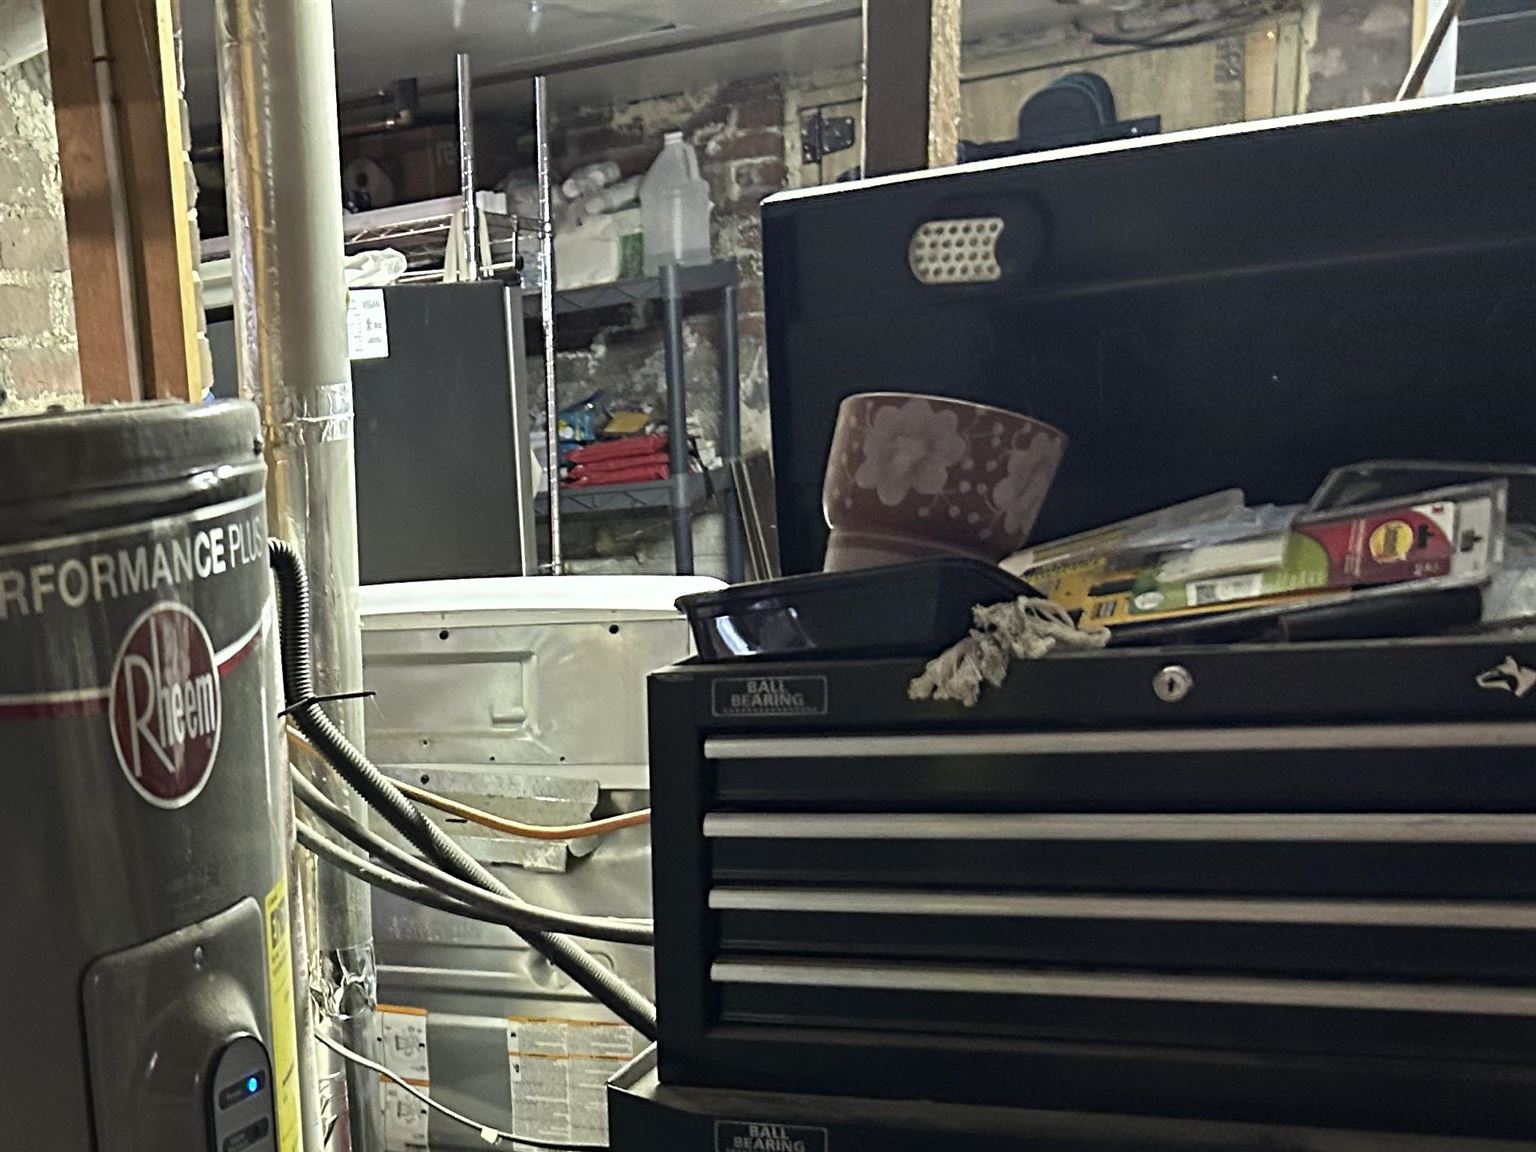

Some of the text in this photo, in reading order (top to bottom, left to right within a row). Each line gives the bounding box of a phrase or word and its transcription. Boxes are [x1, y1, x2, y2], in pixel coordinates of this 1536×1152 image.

[228, 516, 263, 568] PLUS
[747, 680, 786, 693] BALL
[122, 614, 216, 777] Rheem
[731, 693, 804, 707] BEARING
[749, 1125, 788, 1139] BALL
[734, 1138, 805, 1152] BEARING
